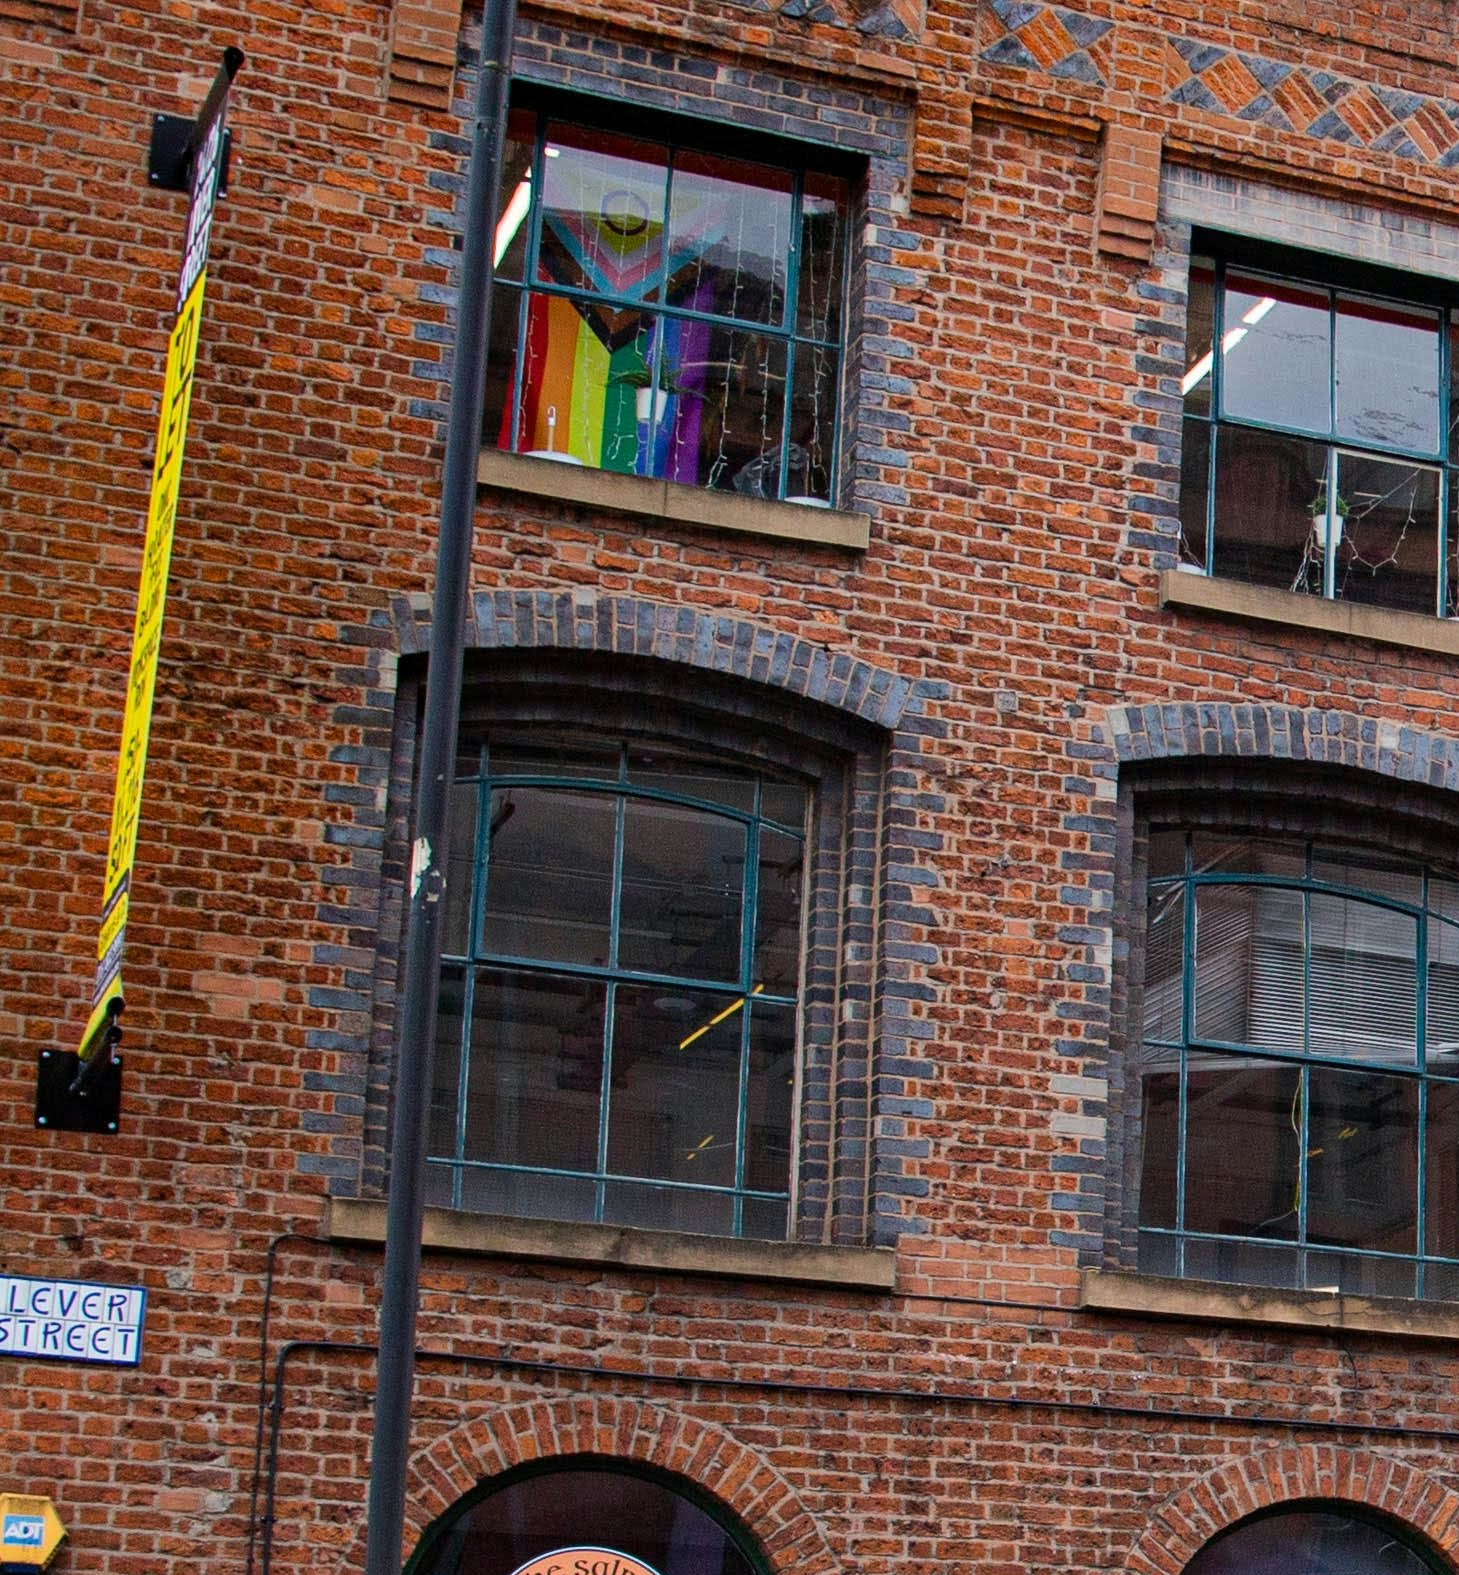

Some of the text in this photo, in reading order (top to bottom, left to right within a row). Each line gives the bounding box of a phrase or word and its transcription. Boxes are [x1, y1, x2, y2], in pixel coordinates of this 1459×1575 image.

[9, 1284, 128, 1322] LEVER
[0, 1317, 136, 1356] STREET
[4, 1521, 44, 1540] ADT
